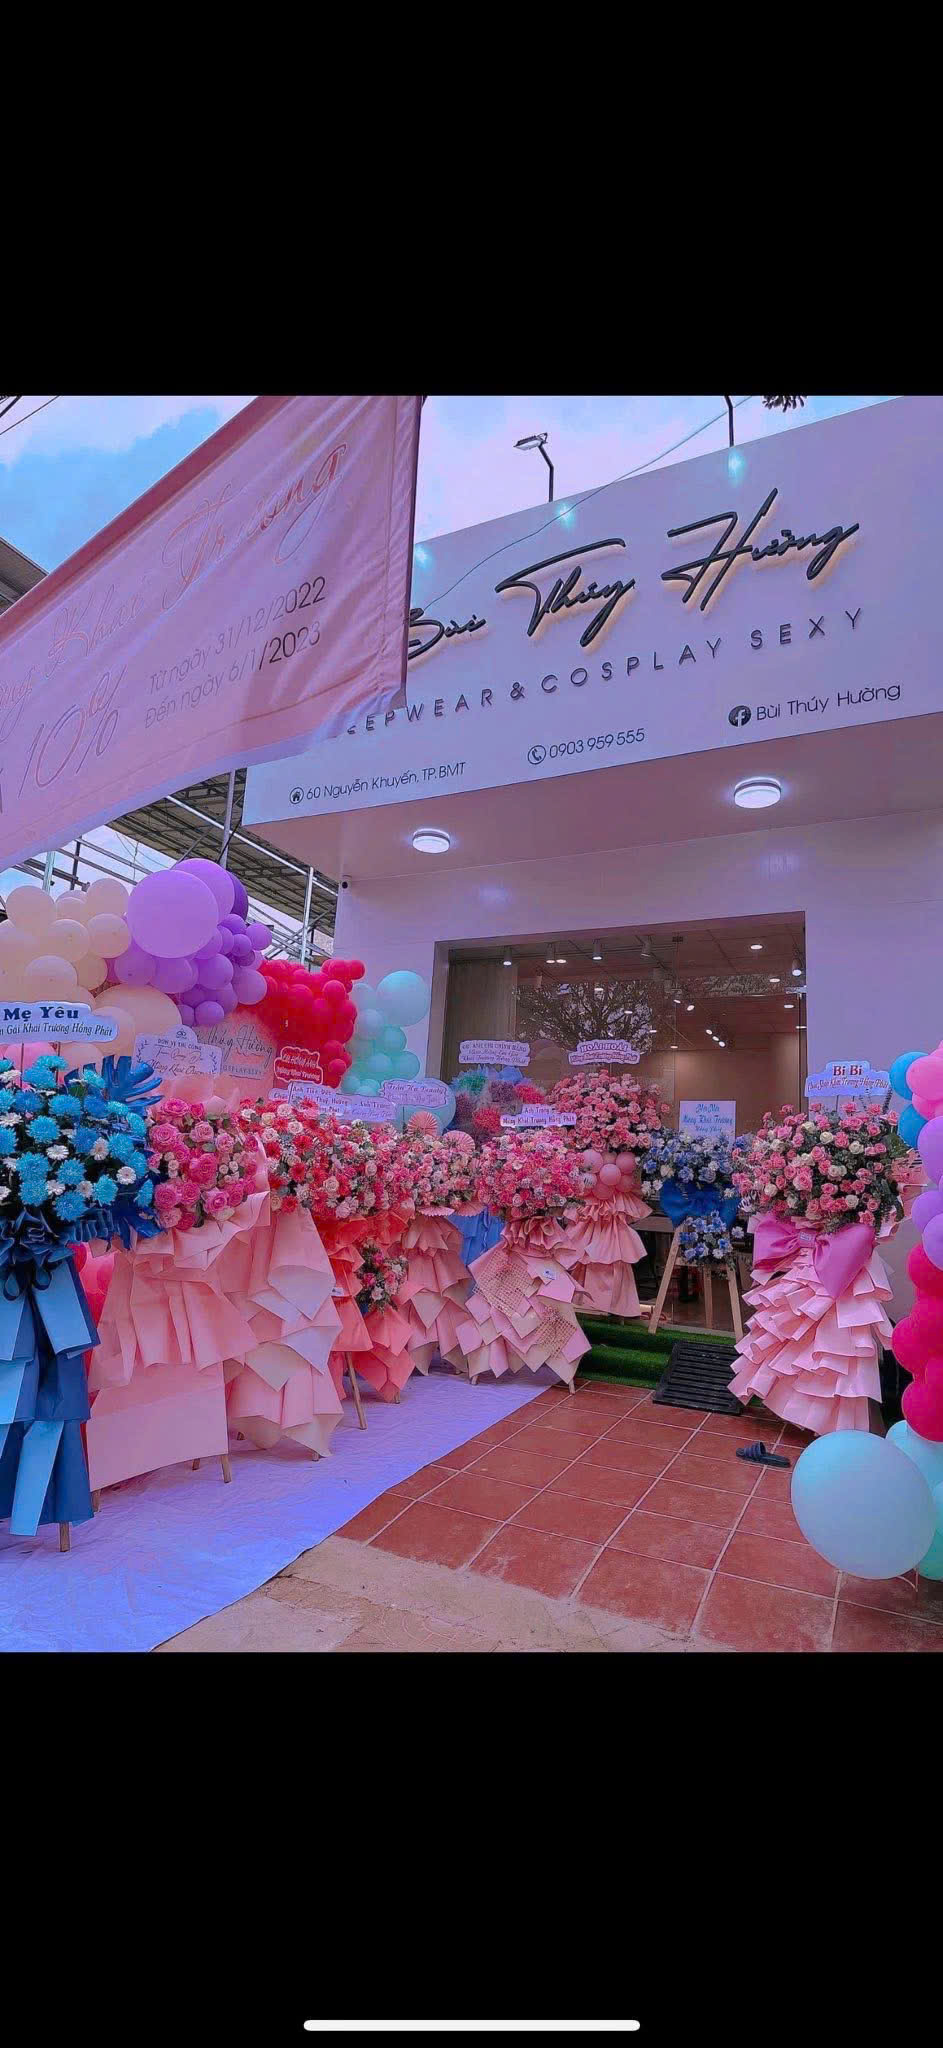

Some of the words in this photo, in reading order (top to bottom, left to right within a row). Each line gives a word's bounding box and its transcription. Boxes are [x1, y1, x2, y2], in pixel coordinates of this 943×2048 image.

[494, 537, 636, 648] Thúy
[660, 487, 860, 612] Hường
[168, 645, 212, 683] ngày
[215, 576, 326, 655] 31/12/2022
[509, 681, 526, 701] &
[540, 637, 722, 694] COSPLAY
[750, 607, 863, 650] SEXY
[144, 695, 176, 729] Đến
[180, 671, 225, 711] ngày
[228, 620, 321, 682] 6/1/2023
[756, 702, 782, 722] Bùi
[786, 696, 830, 717] Thúy
[837, 682, 903, 708] Hường
[17, 665, 128, 801] 10%
[549, 739, 585, 760] 0903
[586, 734, 614, 753] 959
[615, 728, 647, 747] 555
[306, 786, 322, 801] 60
[323, 778, 369, 799] Nguyễn
[4, 1007, 32, 1022] Mẹ
[40, 1006, 79, 1019] Yêu
[23, 1022, 41, 1033] Khai
[94, 1024, 113, 1037] Phát
[832, 1065, 847, 1076] Bi
[849, 1064, 862, 1076] Bi
